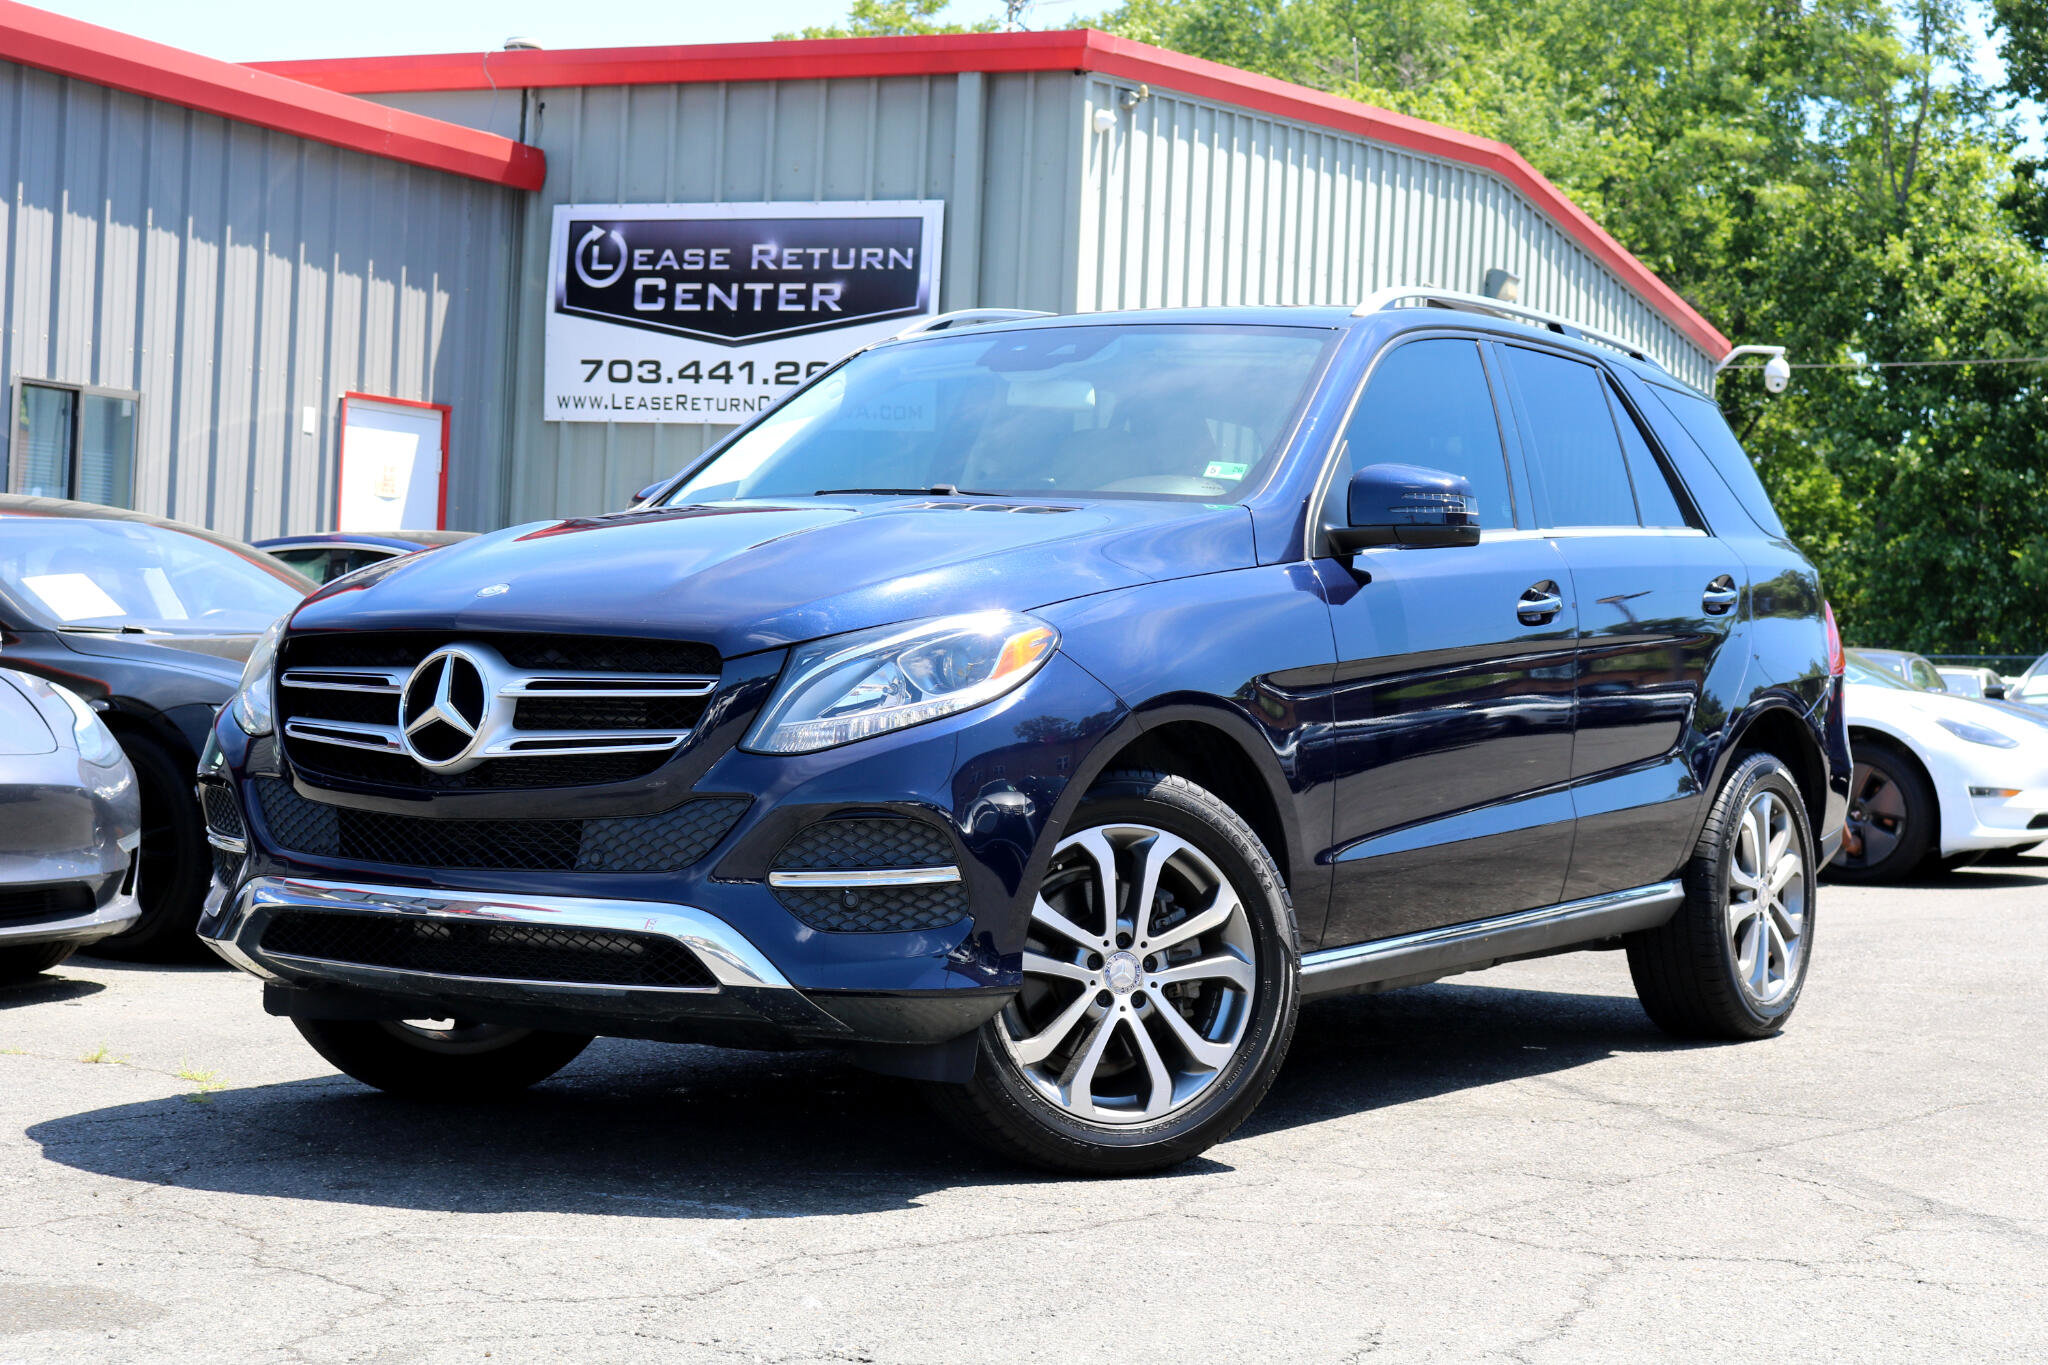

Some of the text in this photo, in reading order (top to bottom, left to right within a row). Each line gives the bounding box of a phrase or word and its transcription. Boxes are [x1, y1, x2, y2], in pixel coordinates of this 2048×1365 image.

[591, 243, 914, 271] LEASE RETURN
[633, 276, 843, 312] CENTER
